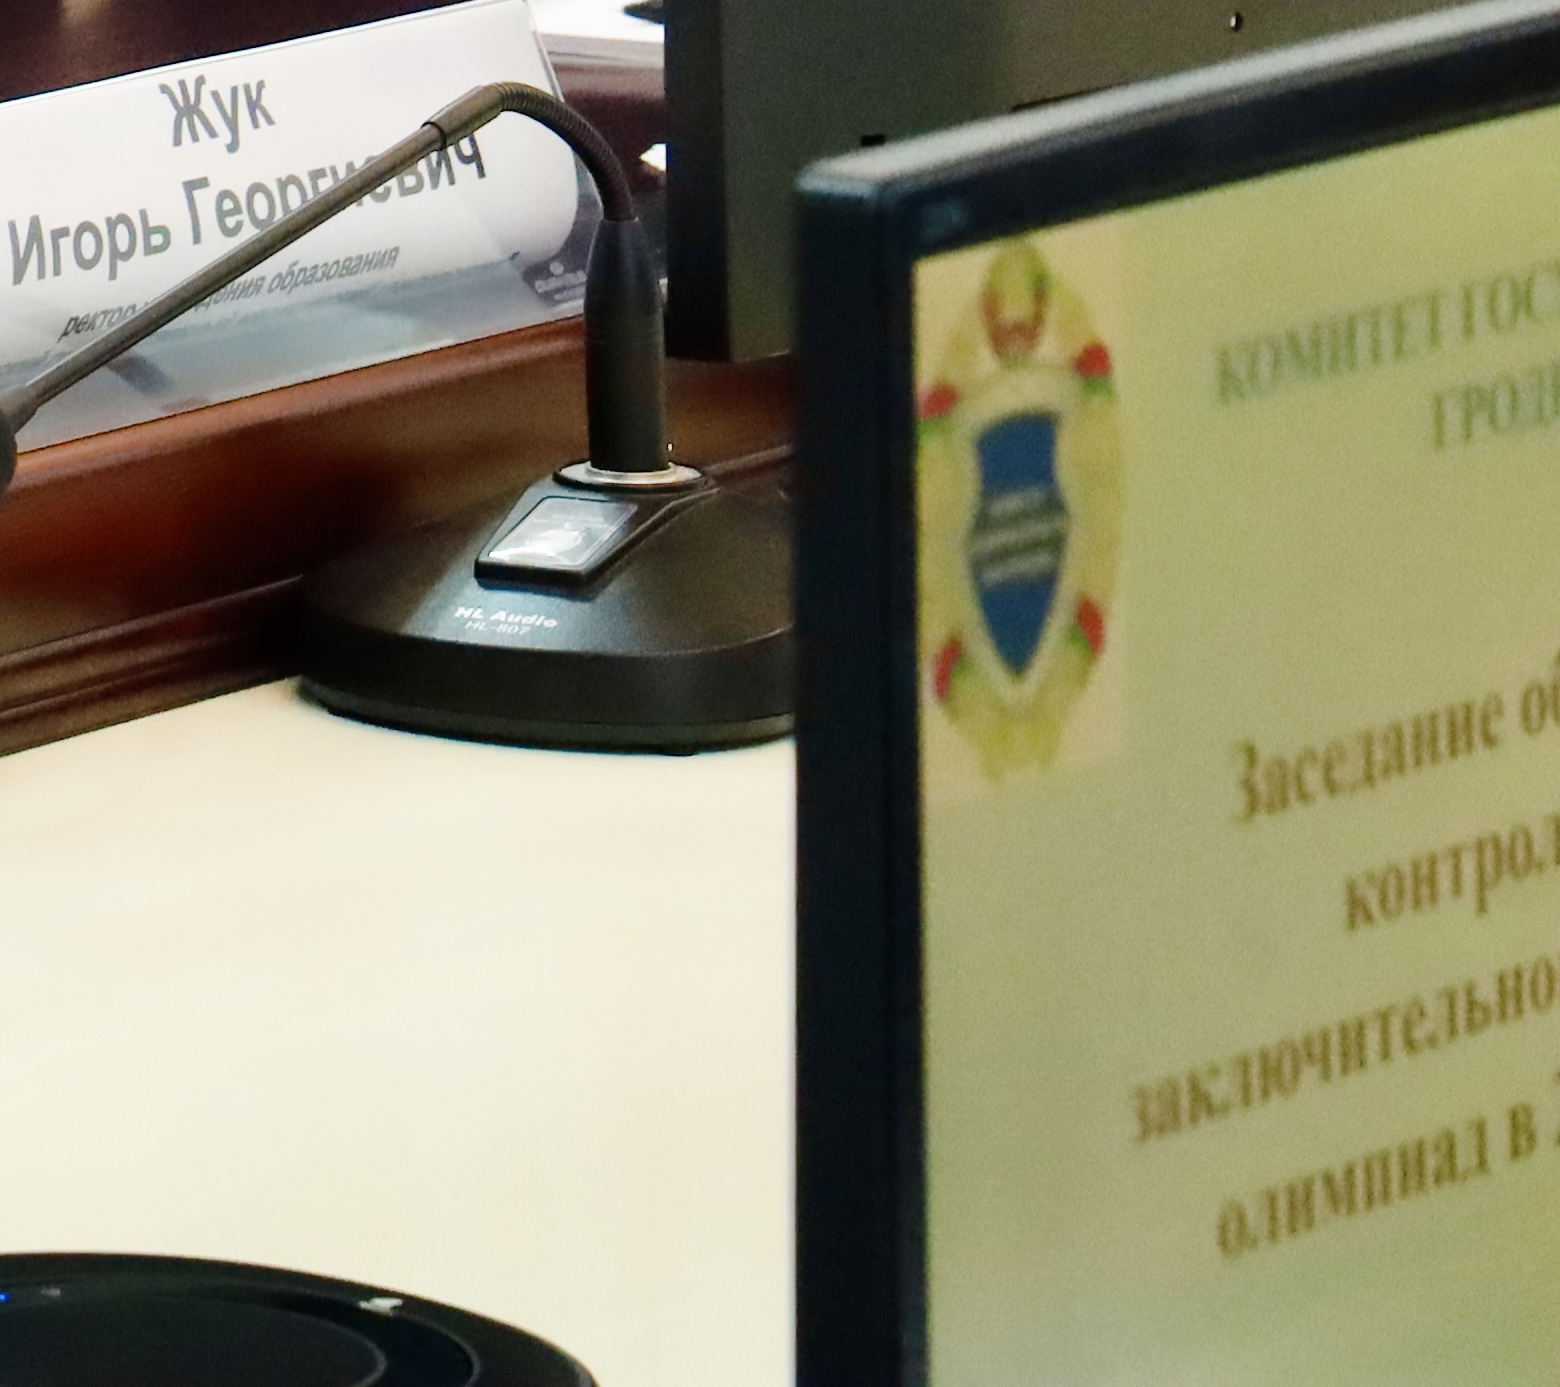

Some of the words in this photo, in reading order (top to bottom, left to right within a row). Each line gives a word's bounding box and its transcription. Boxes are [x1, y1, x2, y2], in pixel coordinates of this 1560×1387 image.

[157, 73, 276, 153] Жук
[7, 205, 172, 289] Игорь
[267, 245, 401, 298] образования
[489, 609, 559, 628] Audio
[1233, 690, 1505, 824] Заседание
[1217, 1115, 1491, 1260] олимпиад
[1508, 1101, 1538, 1164] в
